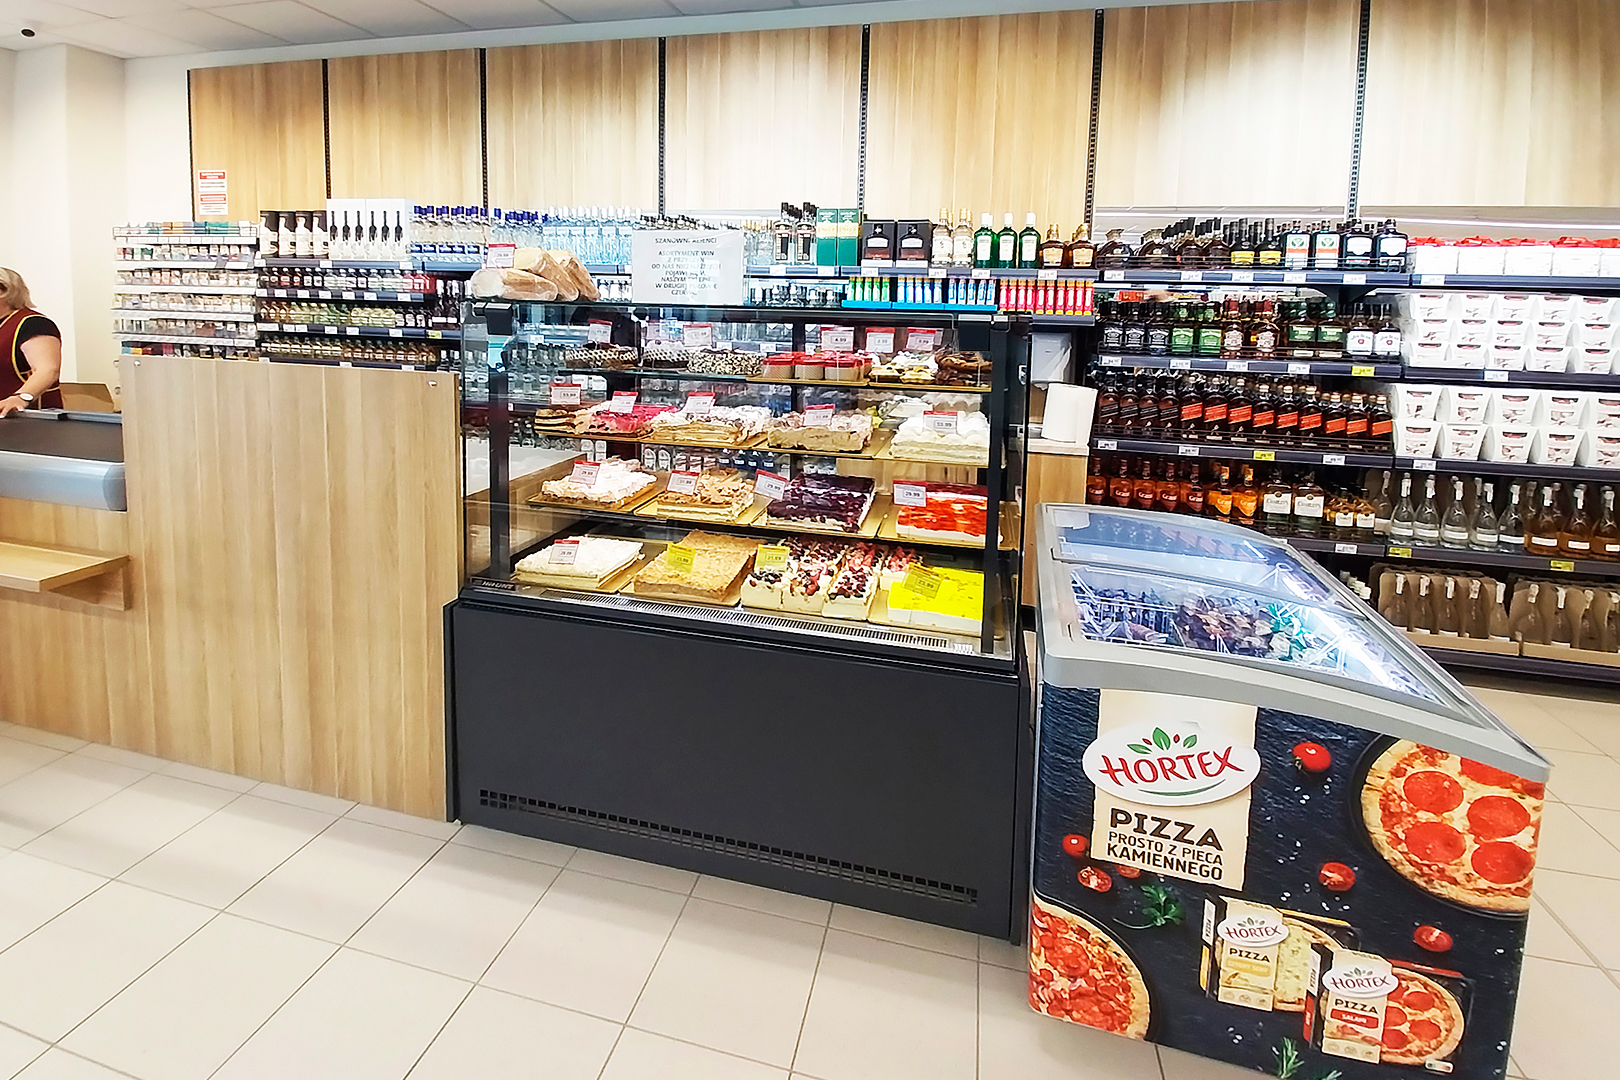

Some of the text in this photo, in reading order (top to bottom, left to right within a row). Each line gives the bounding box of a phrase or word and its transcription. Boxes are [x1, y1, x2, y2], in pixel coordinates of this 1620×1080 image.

[1099, 746, 1245, 787] HORTEX
[1110, 808, 1224, 851] PIZZA
[1108, 831, 1223, 866] PROSTO Z PIECA
[1107, 843, 1223, 881] KAMIENNEGO
[1225, 925, 1282, 939] HORTEX
[1229, 948, 1271, 963] PIZZA
[1330, 976, 1390, 990] HORTEX
[1334, 998, 1379, 1015] PIZZA
